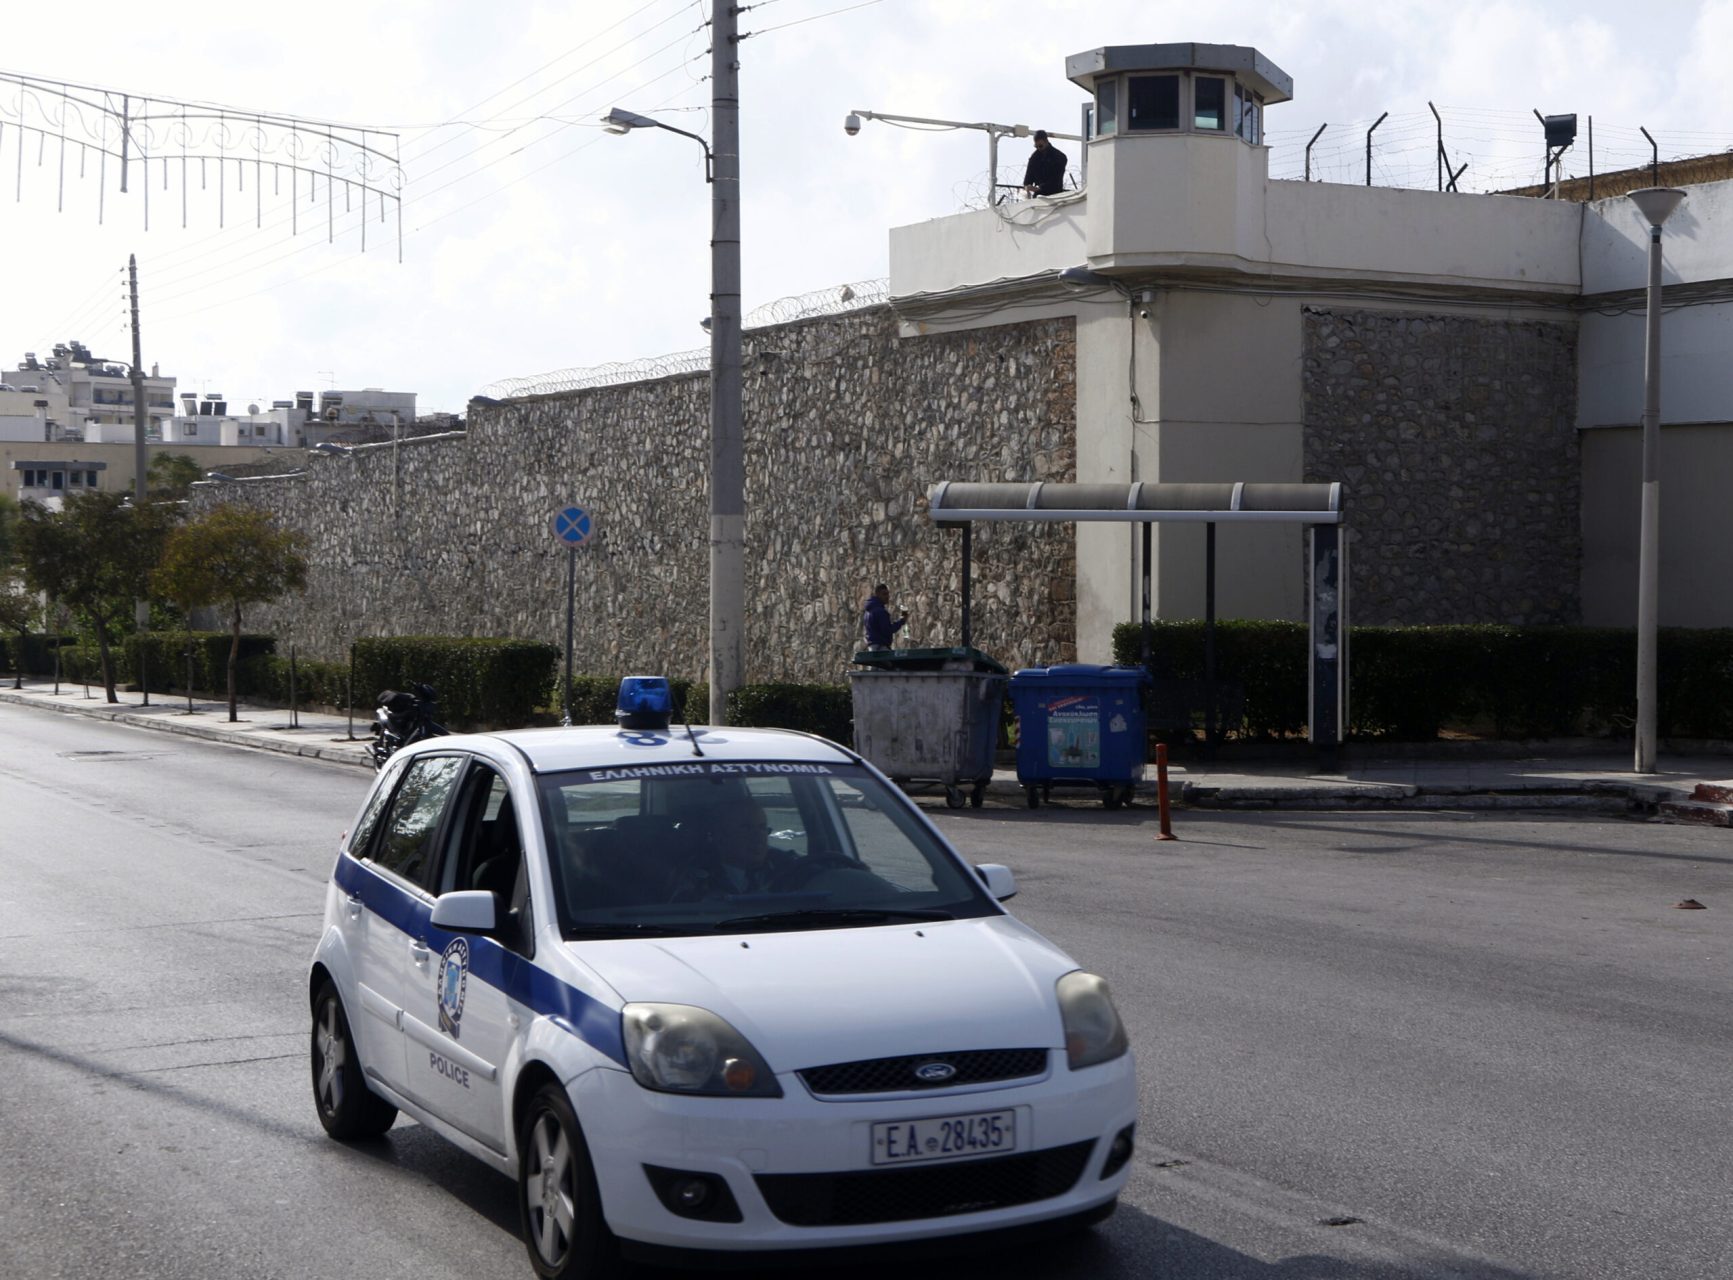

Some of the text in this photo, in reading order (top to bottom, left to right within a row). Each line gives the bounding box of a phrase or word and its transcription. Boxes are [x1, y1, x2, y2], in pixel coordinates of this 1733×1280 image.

[589, 763, 832, 781] ΕΛΛΗΝΙΚΗ ΑΣΤΥΝΟΜΙΑ
[430, 1053, 470, 1089] POLICE
[940, 1116, 1003, 1152] 28435
